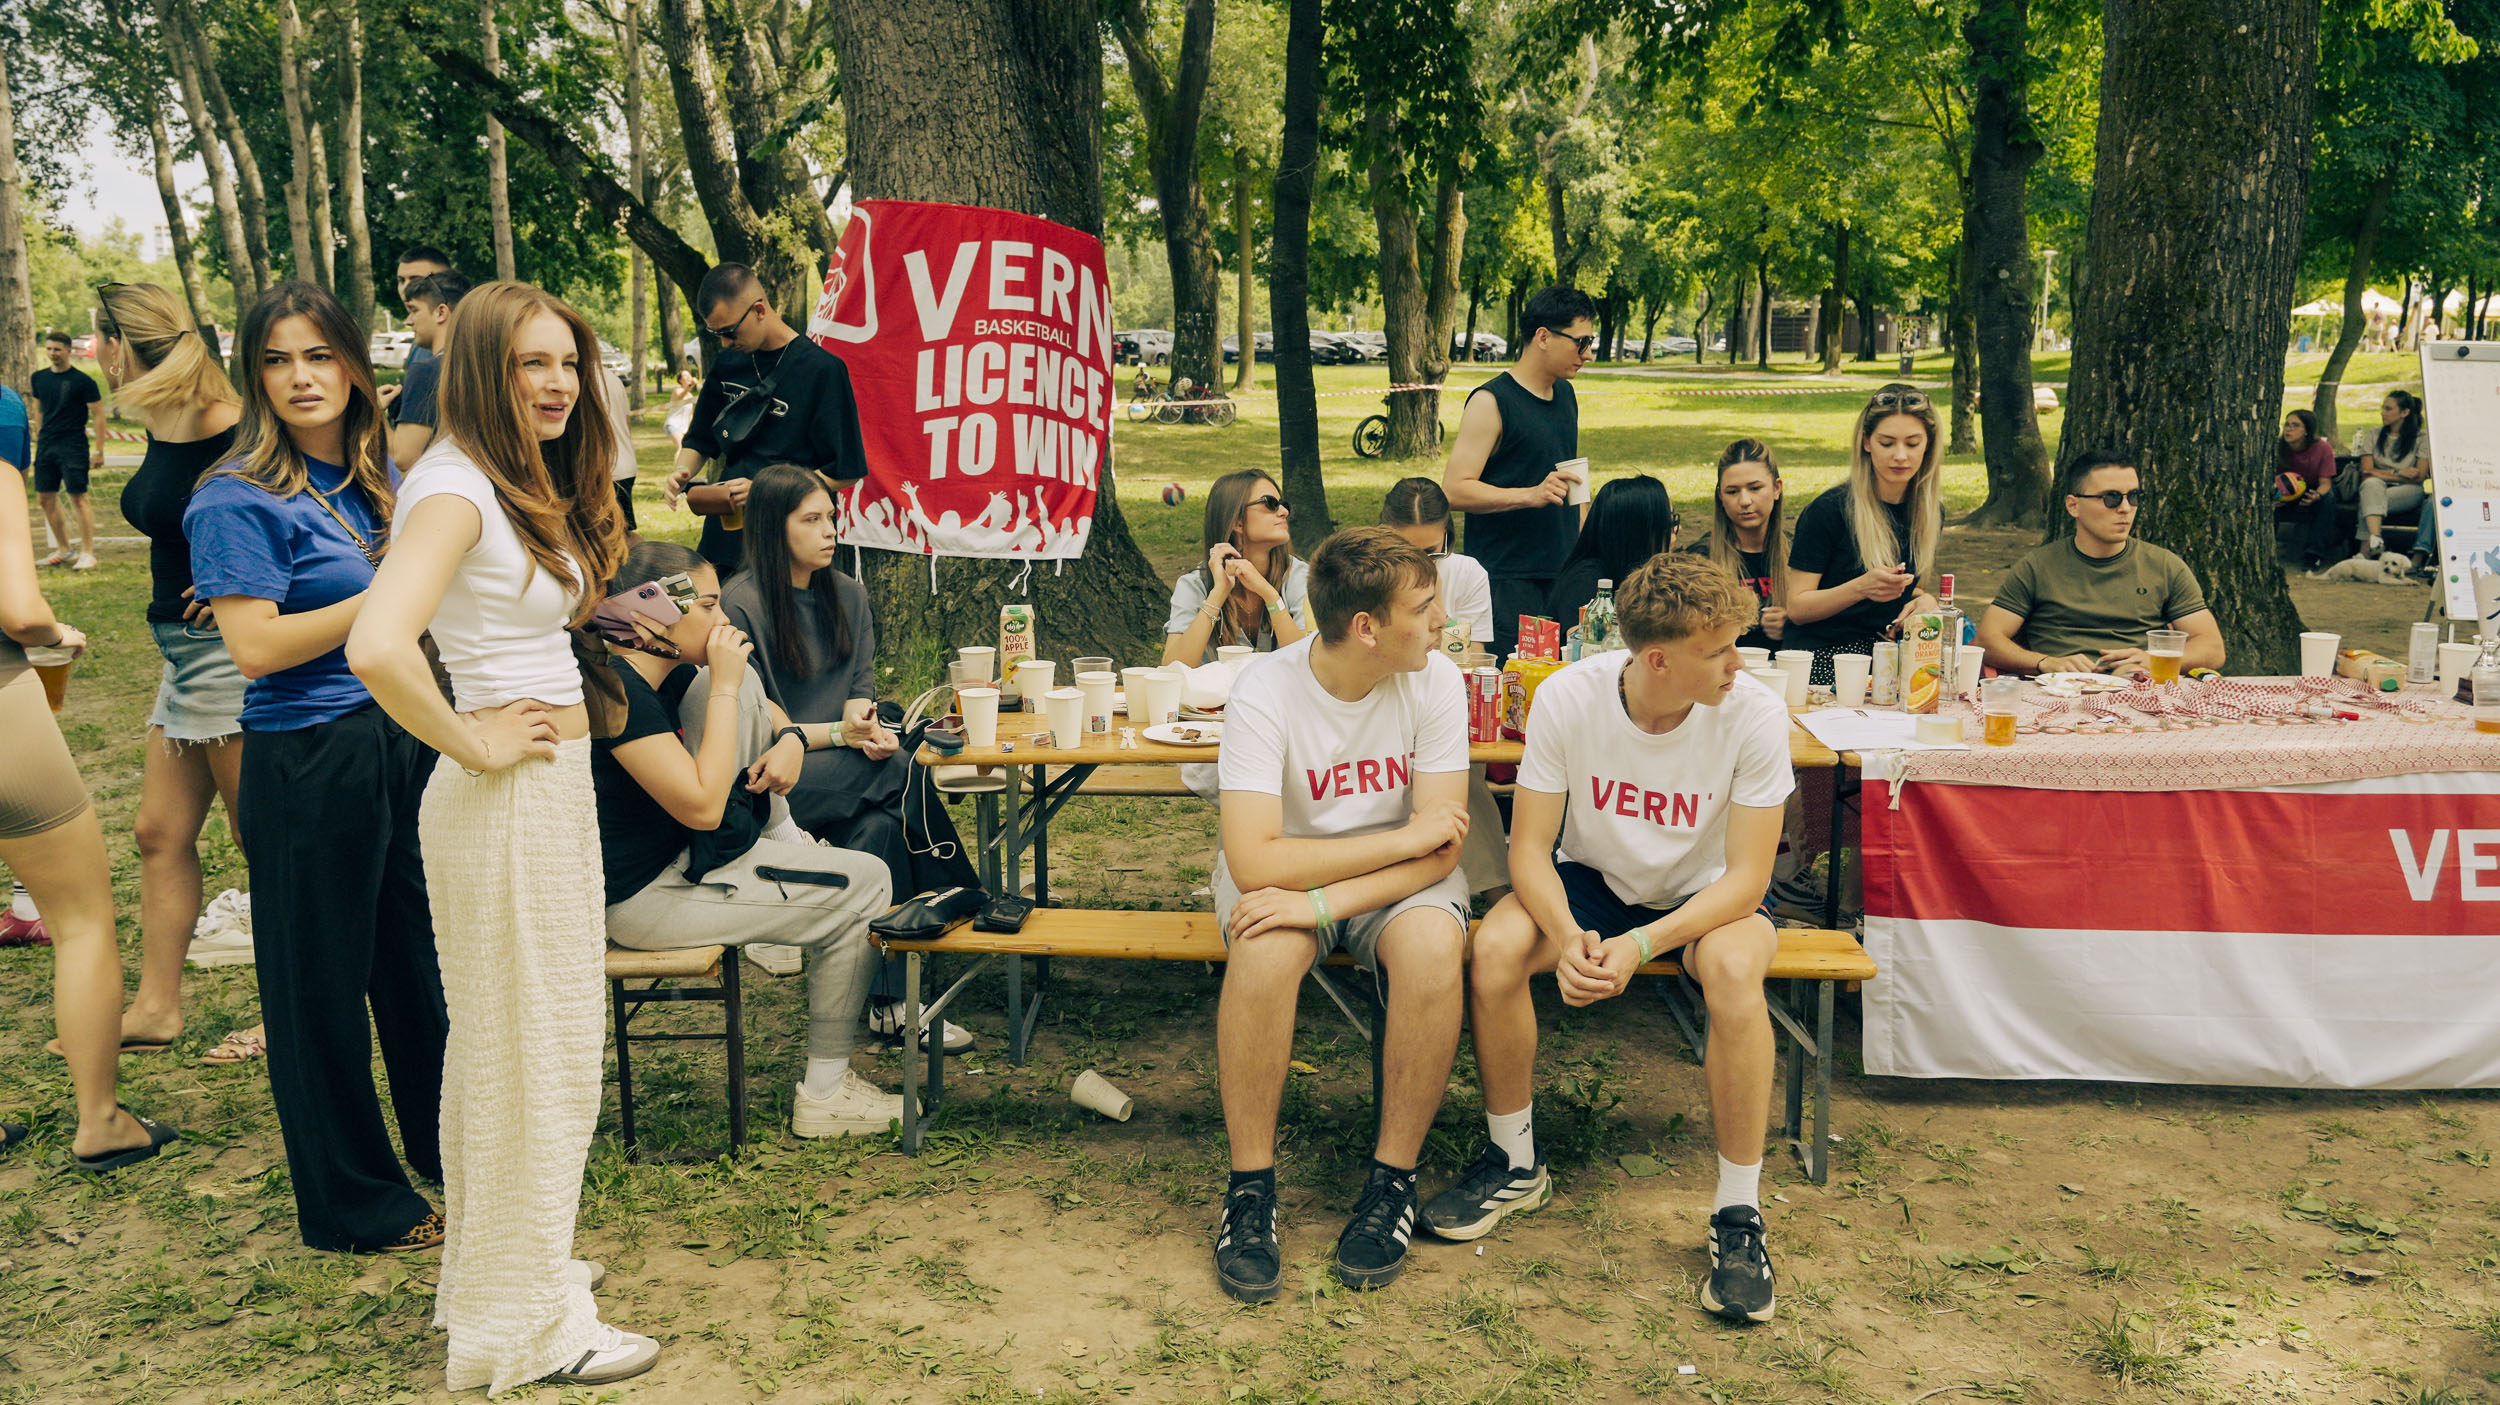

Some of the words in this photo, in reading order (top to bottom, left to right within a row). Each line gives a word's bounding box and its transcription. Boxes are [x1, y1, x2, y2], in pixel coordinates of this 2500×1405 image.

[974, 318, 1072, 350] BASKETBALL
[915, 341, 1105, 431] LICENCE
[923, 412, 998, 480] TO
[1012, 413, 1099, 491] WIN
[1004, 634, 1027, 643] 100%
[1005, 642, 1028, 651] APPLE
[2388, 828, 2500, 902] VE
